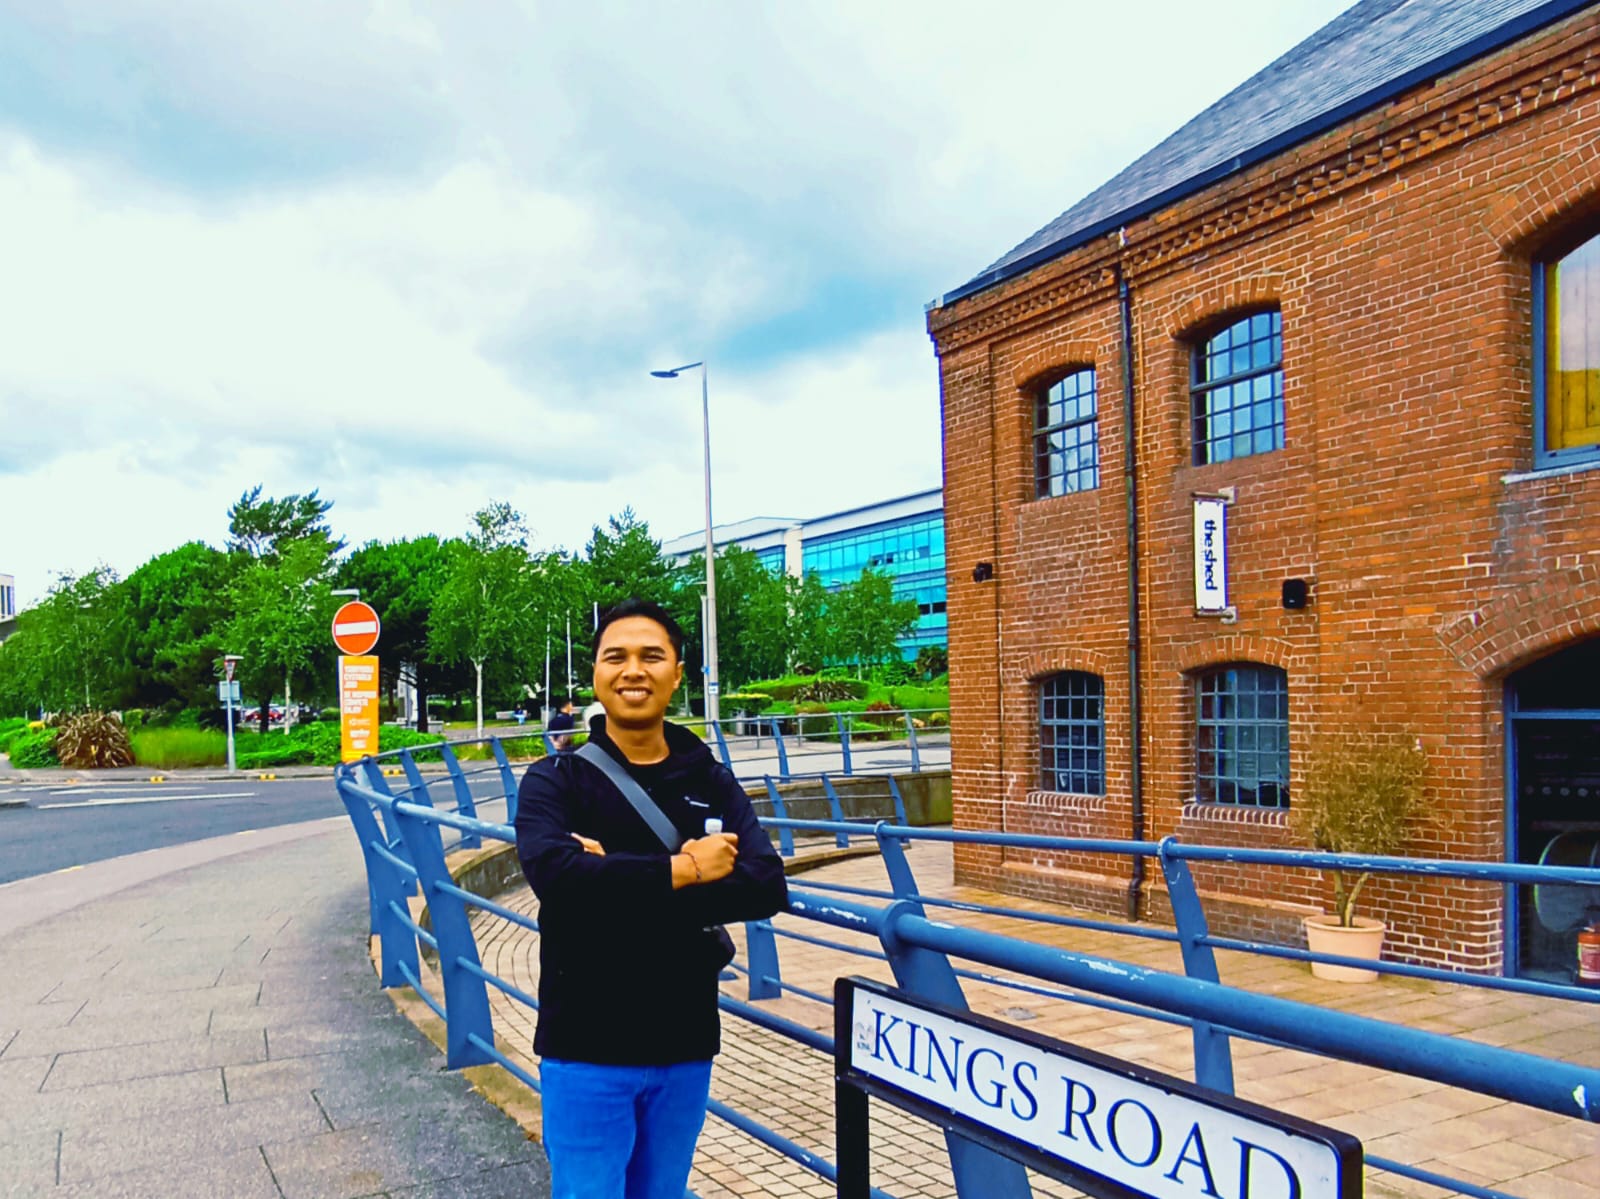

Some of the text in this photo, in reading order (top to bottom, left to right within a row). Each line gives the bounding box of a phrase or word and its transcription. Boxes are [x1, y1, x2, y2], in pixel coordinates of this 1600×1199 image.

[1204, 519, 1218, 591] the shed
[870, 1008, 1303, 1199] KINGS ROAD
